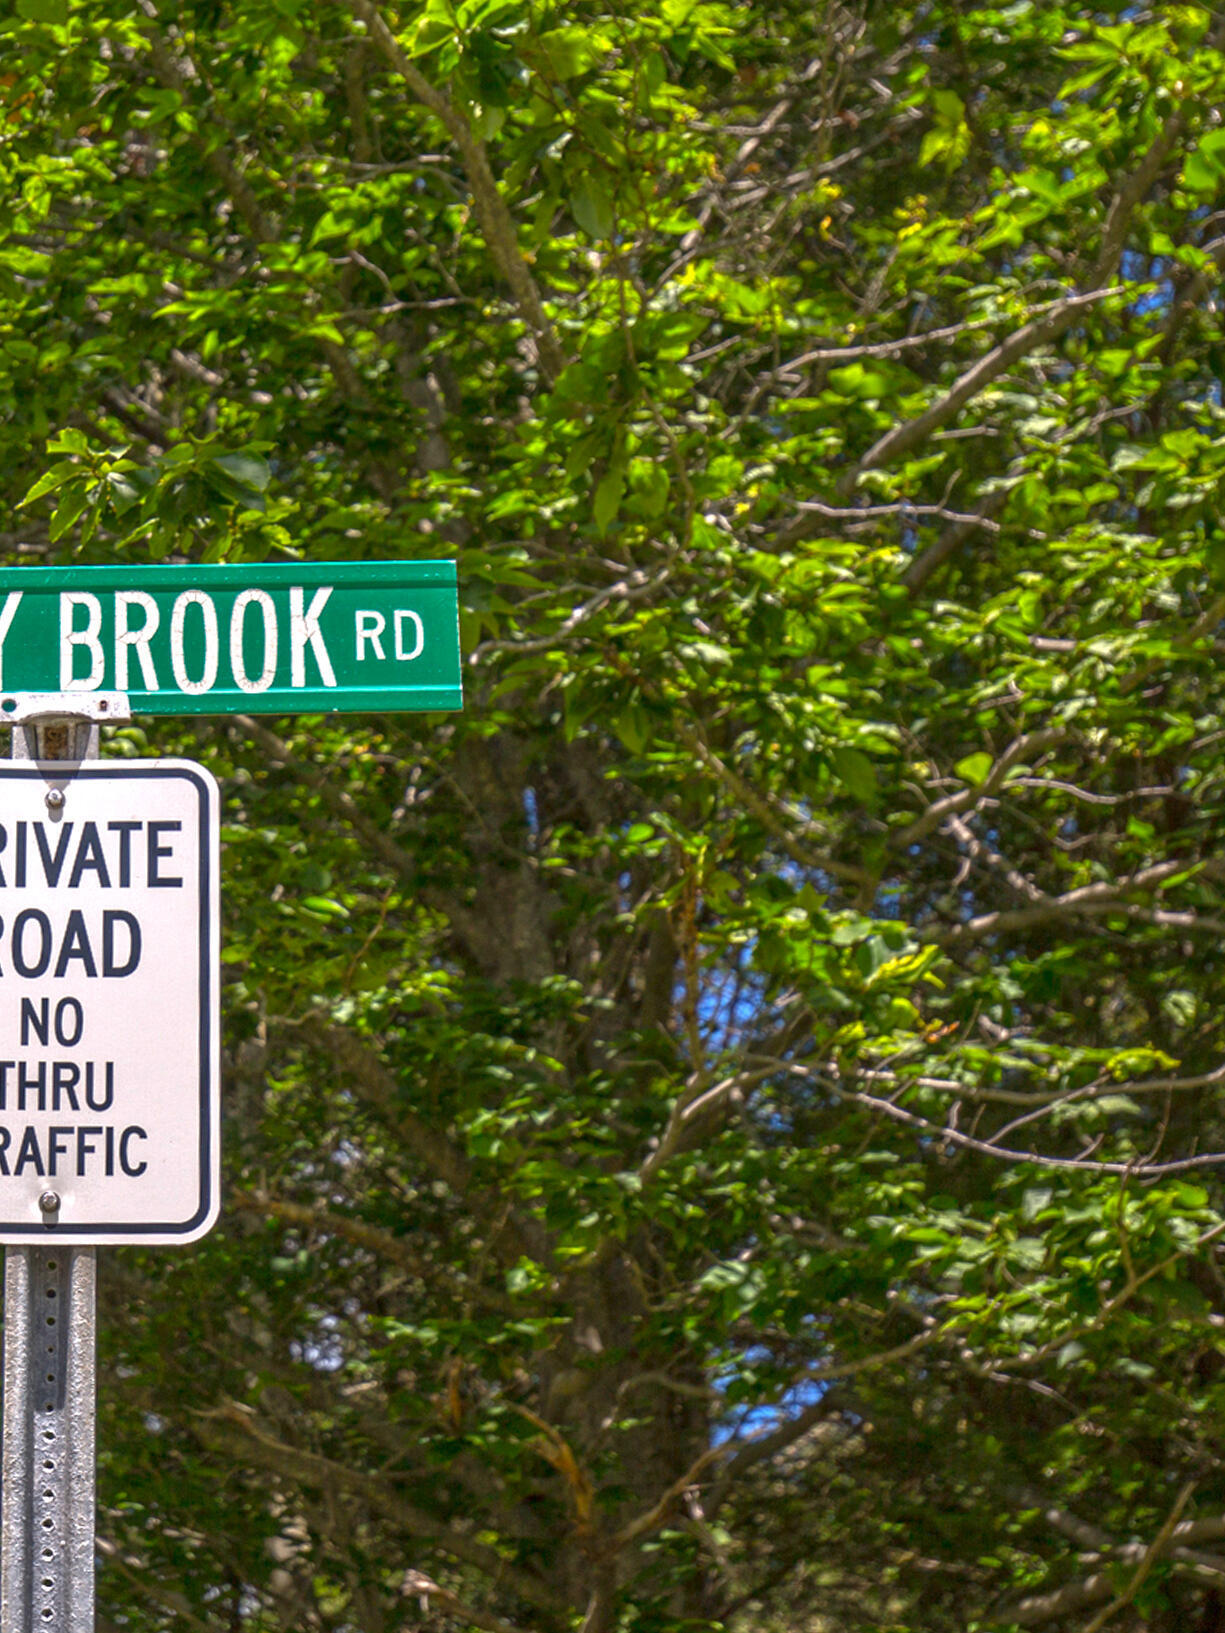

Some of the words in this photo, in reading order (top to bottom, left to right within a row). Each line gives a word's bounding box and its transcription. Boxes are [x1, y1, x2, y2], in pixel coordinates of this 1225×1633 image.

[59, 586, 337, 695] BROOK
[356, 609, 425, 662] RD
[19, 996, 84, 1047] NO
